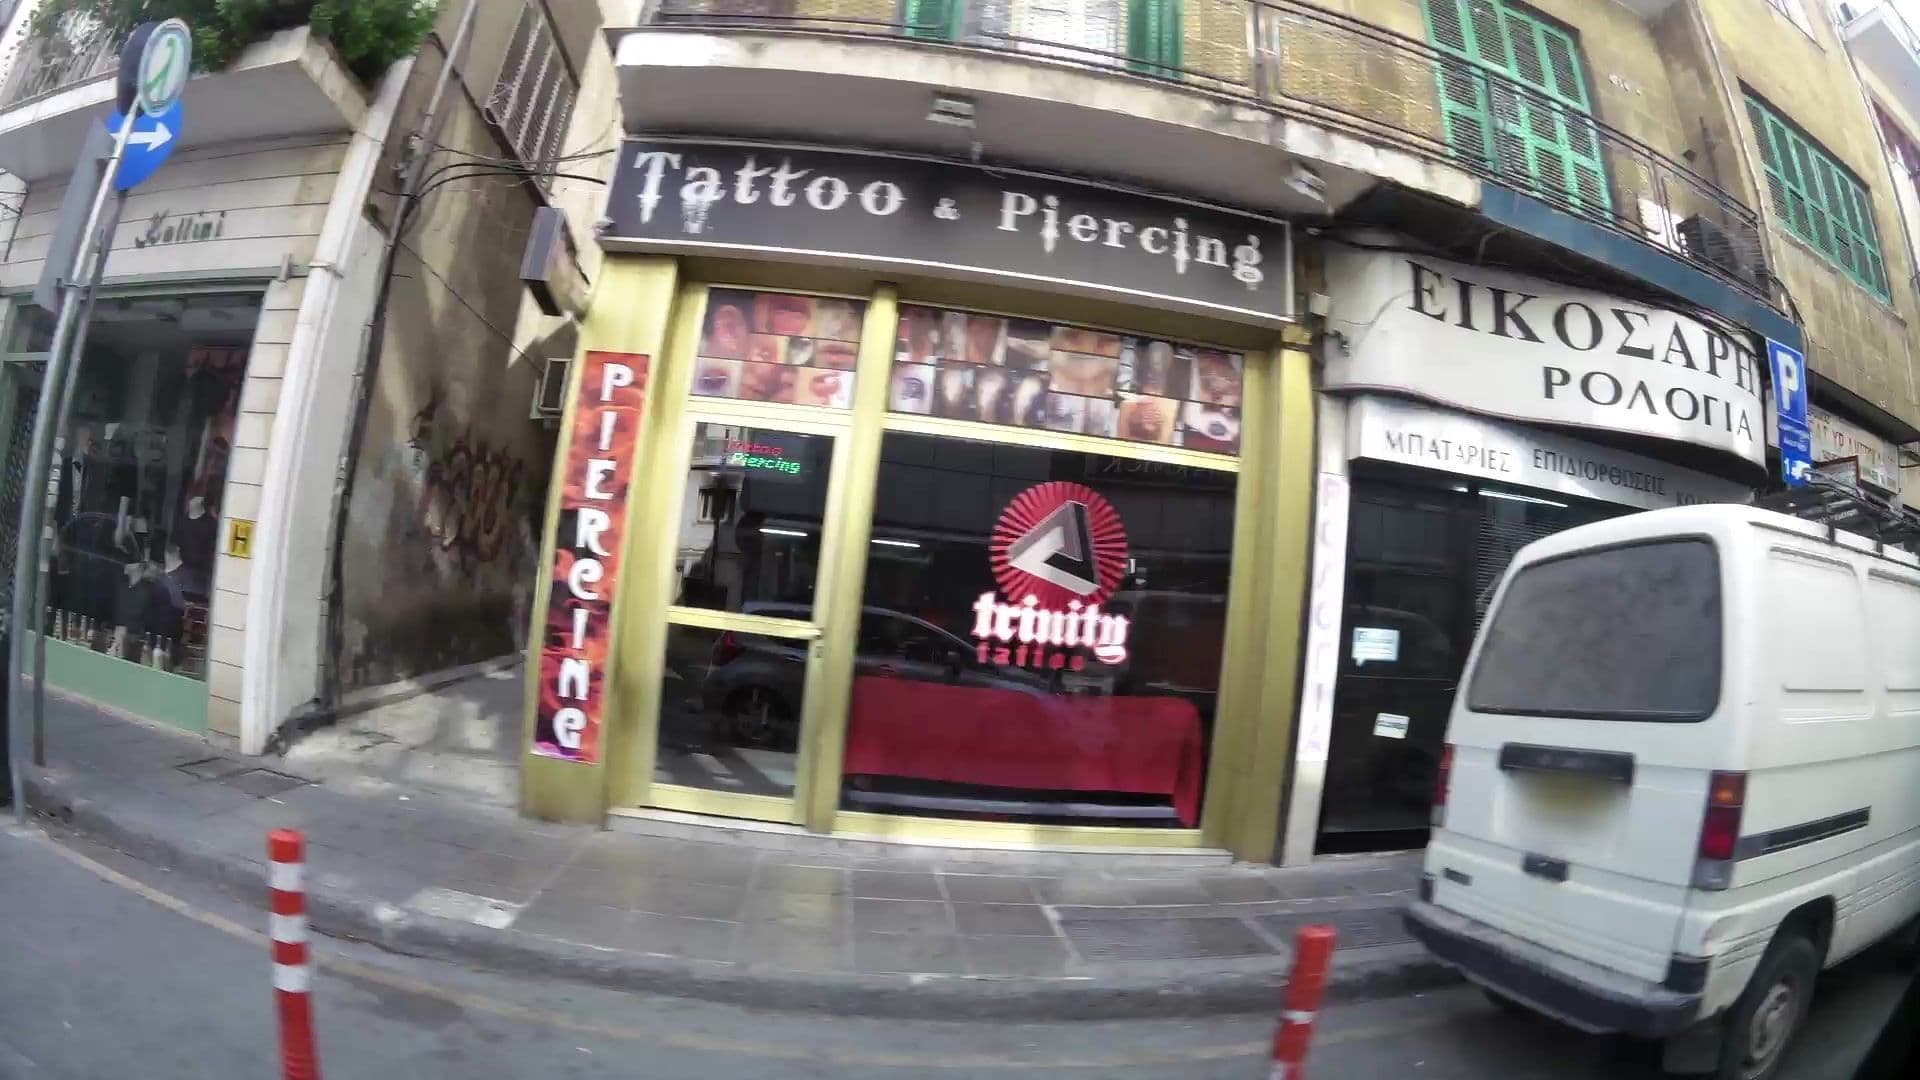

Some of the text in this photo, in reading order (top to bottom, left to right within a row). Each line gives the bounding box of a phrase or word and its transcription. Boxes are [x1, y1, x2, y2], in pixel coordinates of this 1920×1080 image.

[633, 152, 1265, 290] Tattoo & Piercing
[1407, 260, 1760, 396] ΕΙΚΟΣΑΡΗ
[1543, 365, 1753, 443] ΡΟΛΟΓΙΑ
[1776, 350, 1799, 411] P
[730, 452, 801, 474] Piercing
[971, 591, 1131, 665] trinity
